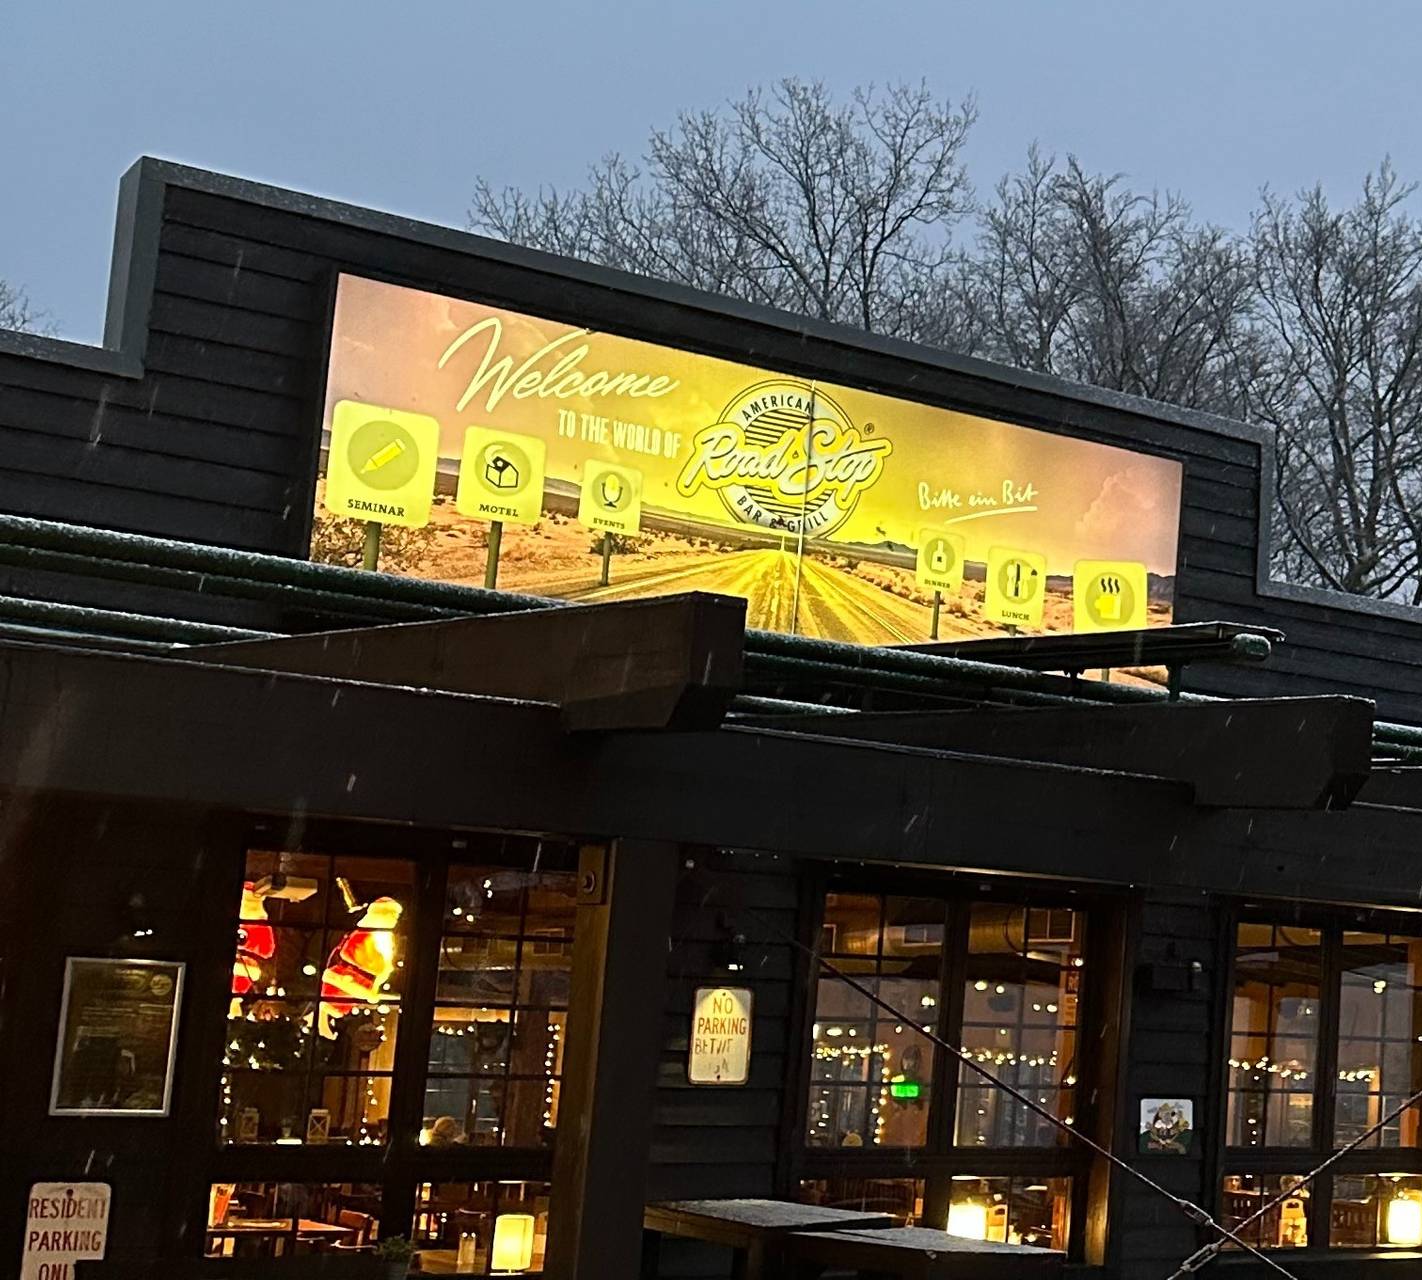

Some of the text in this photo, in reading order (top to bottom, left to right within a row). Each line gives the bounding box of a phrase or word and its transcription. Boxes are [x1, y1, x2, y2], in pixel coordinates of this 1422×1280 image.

[438, 316, 681, 413] Welcome
[741, 394, 815, 422] AMERICAN
[558, 408, 682, 459] TO THE WORLD OF
[683, 428, 888, 503] Road Stop
[918, 479, 1039, 510] Bitte ein Bit
[347, 498, 405, 518] SEMINAR
[479, 503, 520, 518] MOTEL
[737, 495, 763, 521] BAR
[593, 517, 626, 530] EVENTS
[1001, 610, 1030, 621] LUNCH
[713, 998, 734, 1015] NO
[697, 1017, 747, 1036] PARKING
[29, 1198, 107, 1219] RESIDENT
[28, 1230, 102, 1251] PARKING
